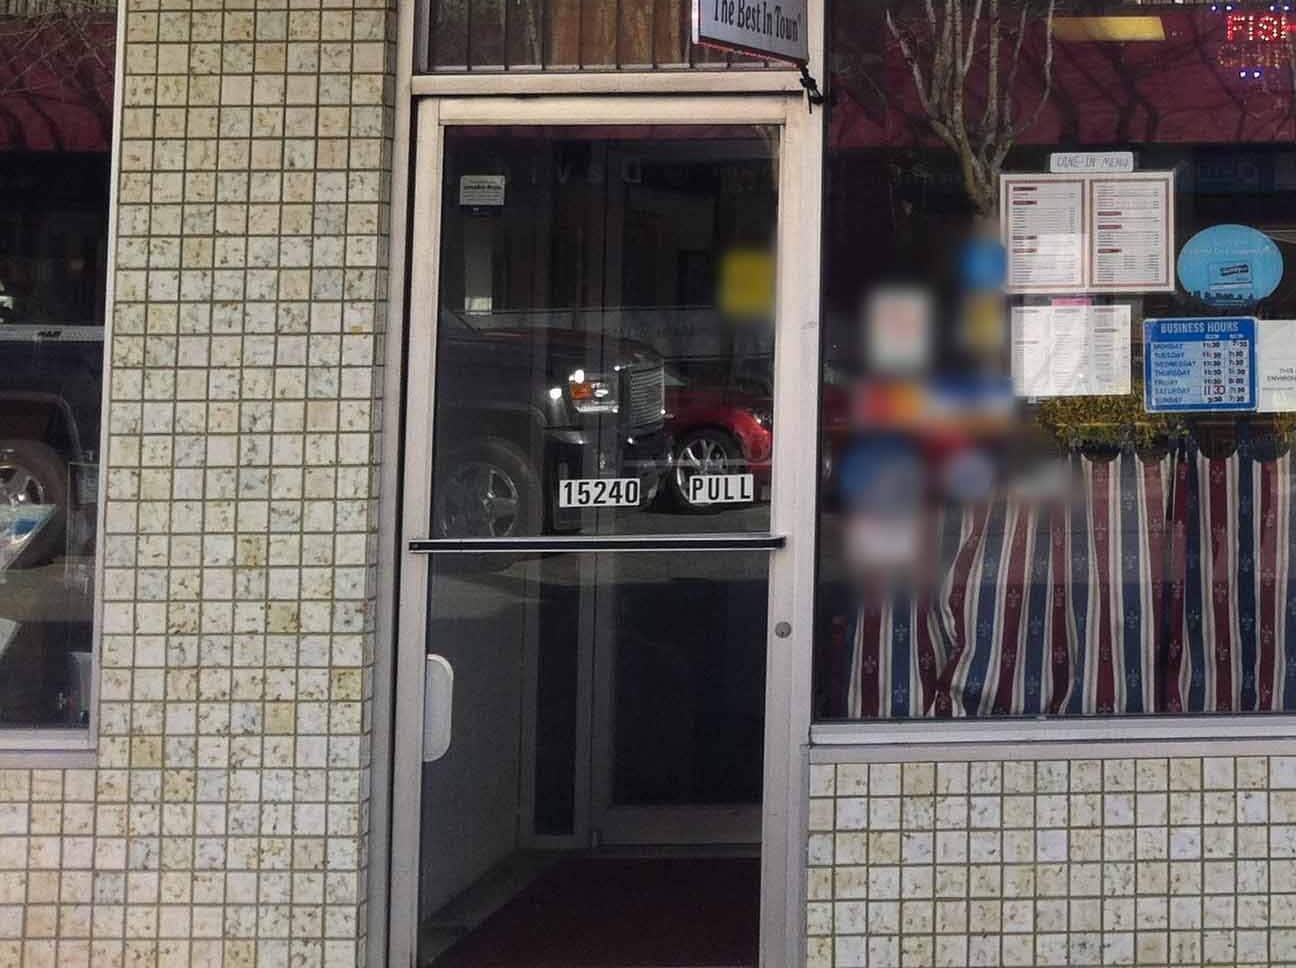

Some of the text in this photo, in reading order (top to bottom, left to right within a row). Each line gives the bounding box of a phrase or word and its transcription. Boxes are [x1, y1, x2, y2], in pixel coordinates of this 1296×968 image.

[763, 1, 773, 34] In
[1160, 321, 1239, 333] BUSINESS HOURS
[563, 480, 638, 505] 15240
[692, 476, 750, 501] PULL
